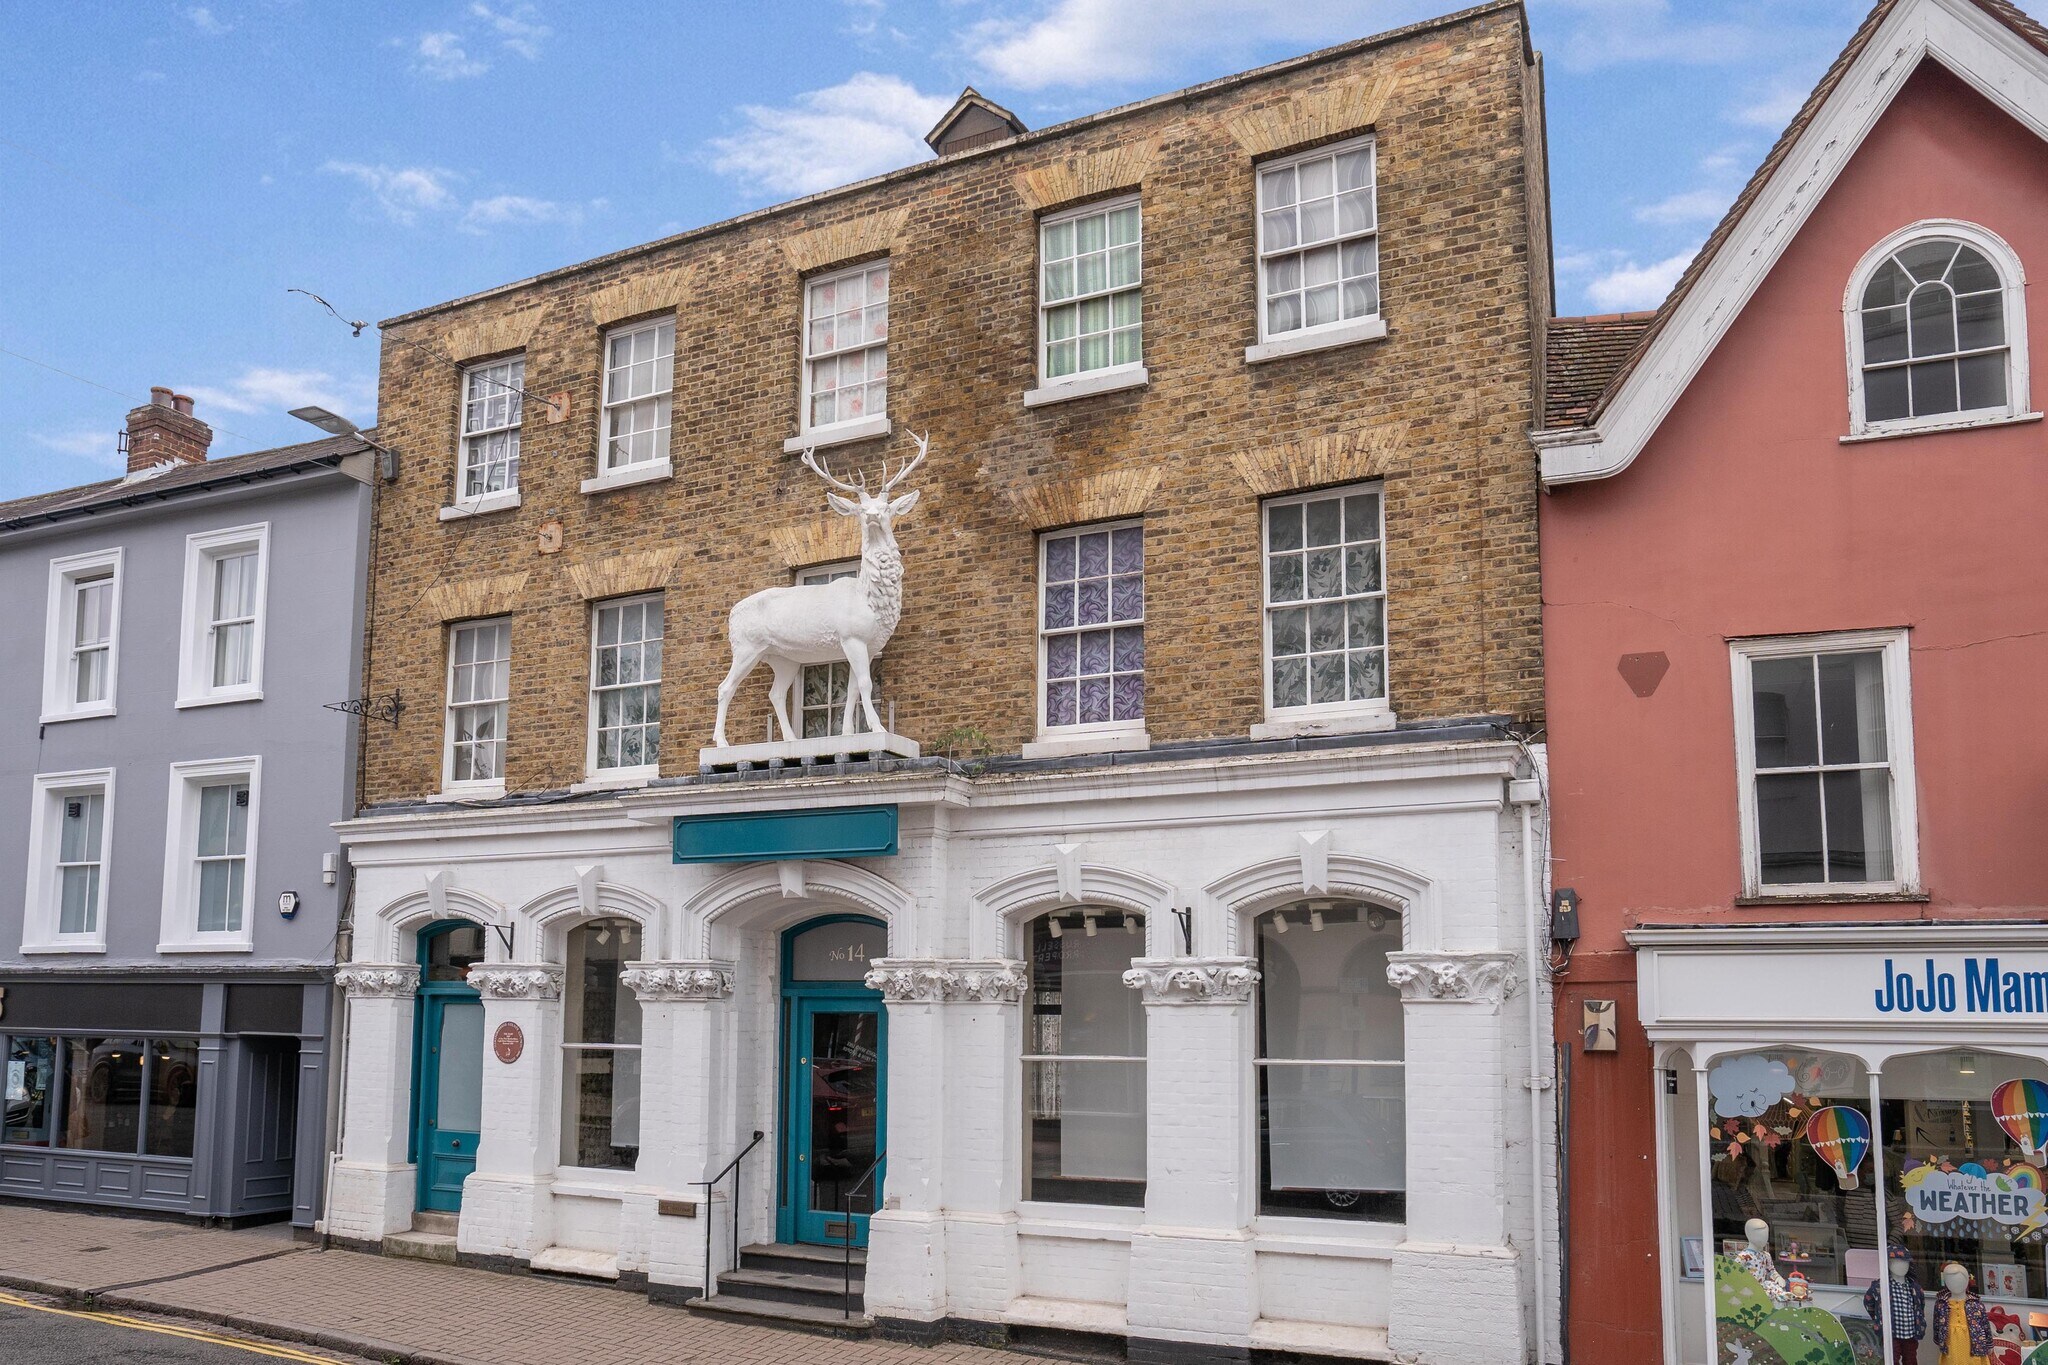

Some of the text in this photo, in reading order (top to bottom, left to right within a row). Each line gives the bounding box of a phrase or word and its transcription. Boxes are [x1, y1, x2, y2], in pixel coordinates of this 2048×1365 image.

[829, 944, 865, 962] No 14
[1875, 959, 1956, 1013] JoJo
[1947, 1179, 1992, 1192] Whatever the
[1920, 1190, 2029, 1217] WEATHER
